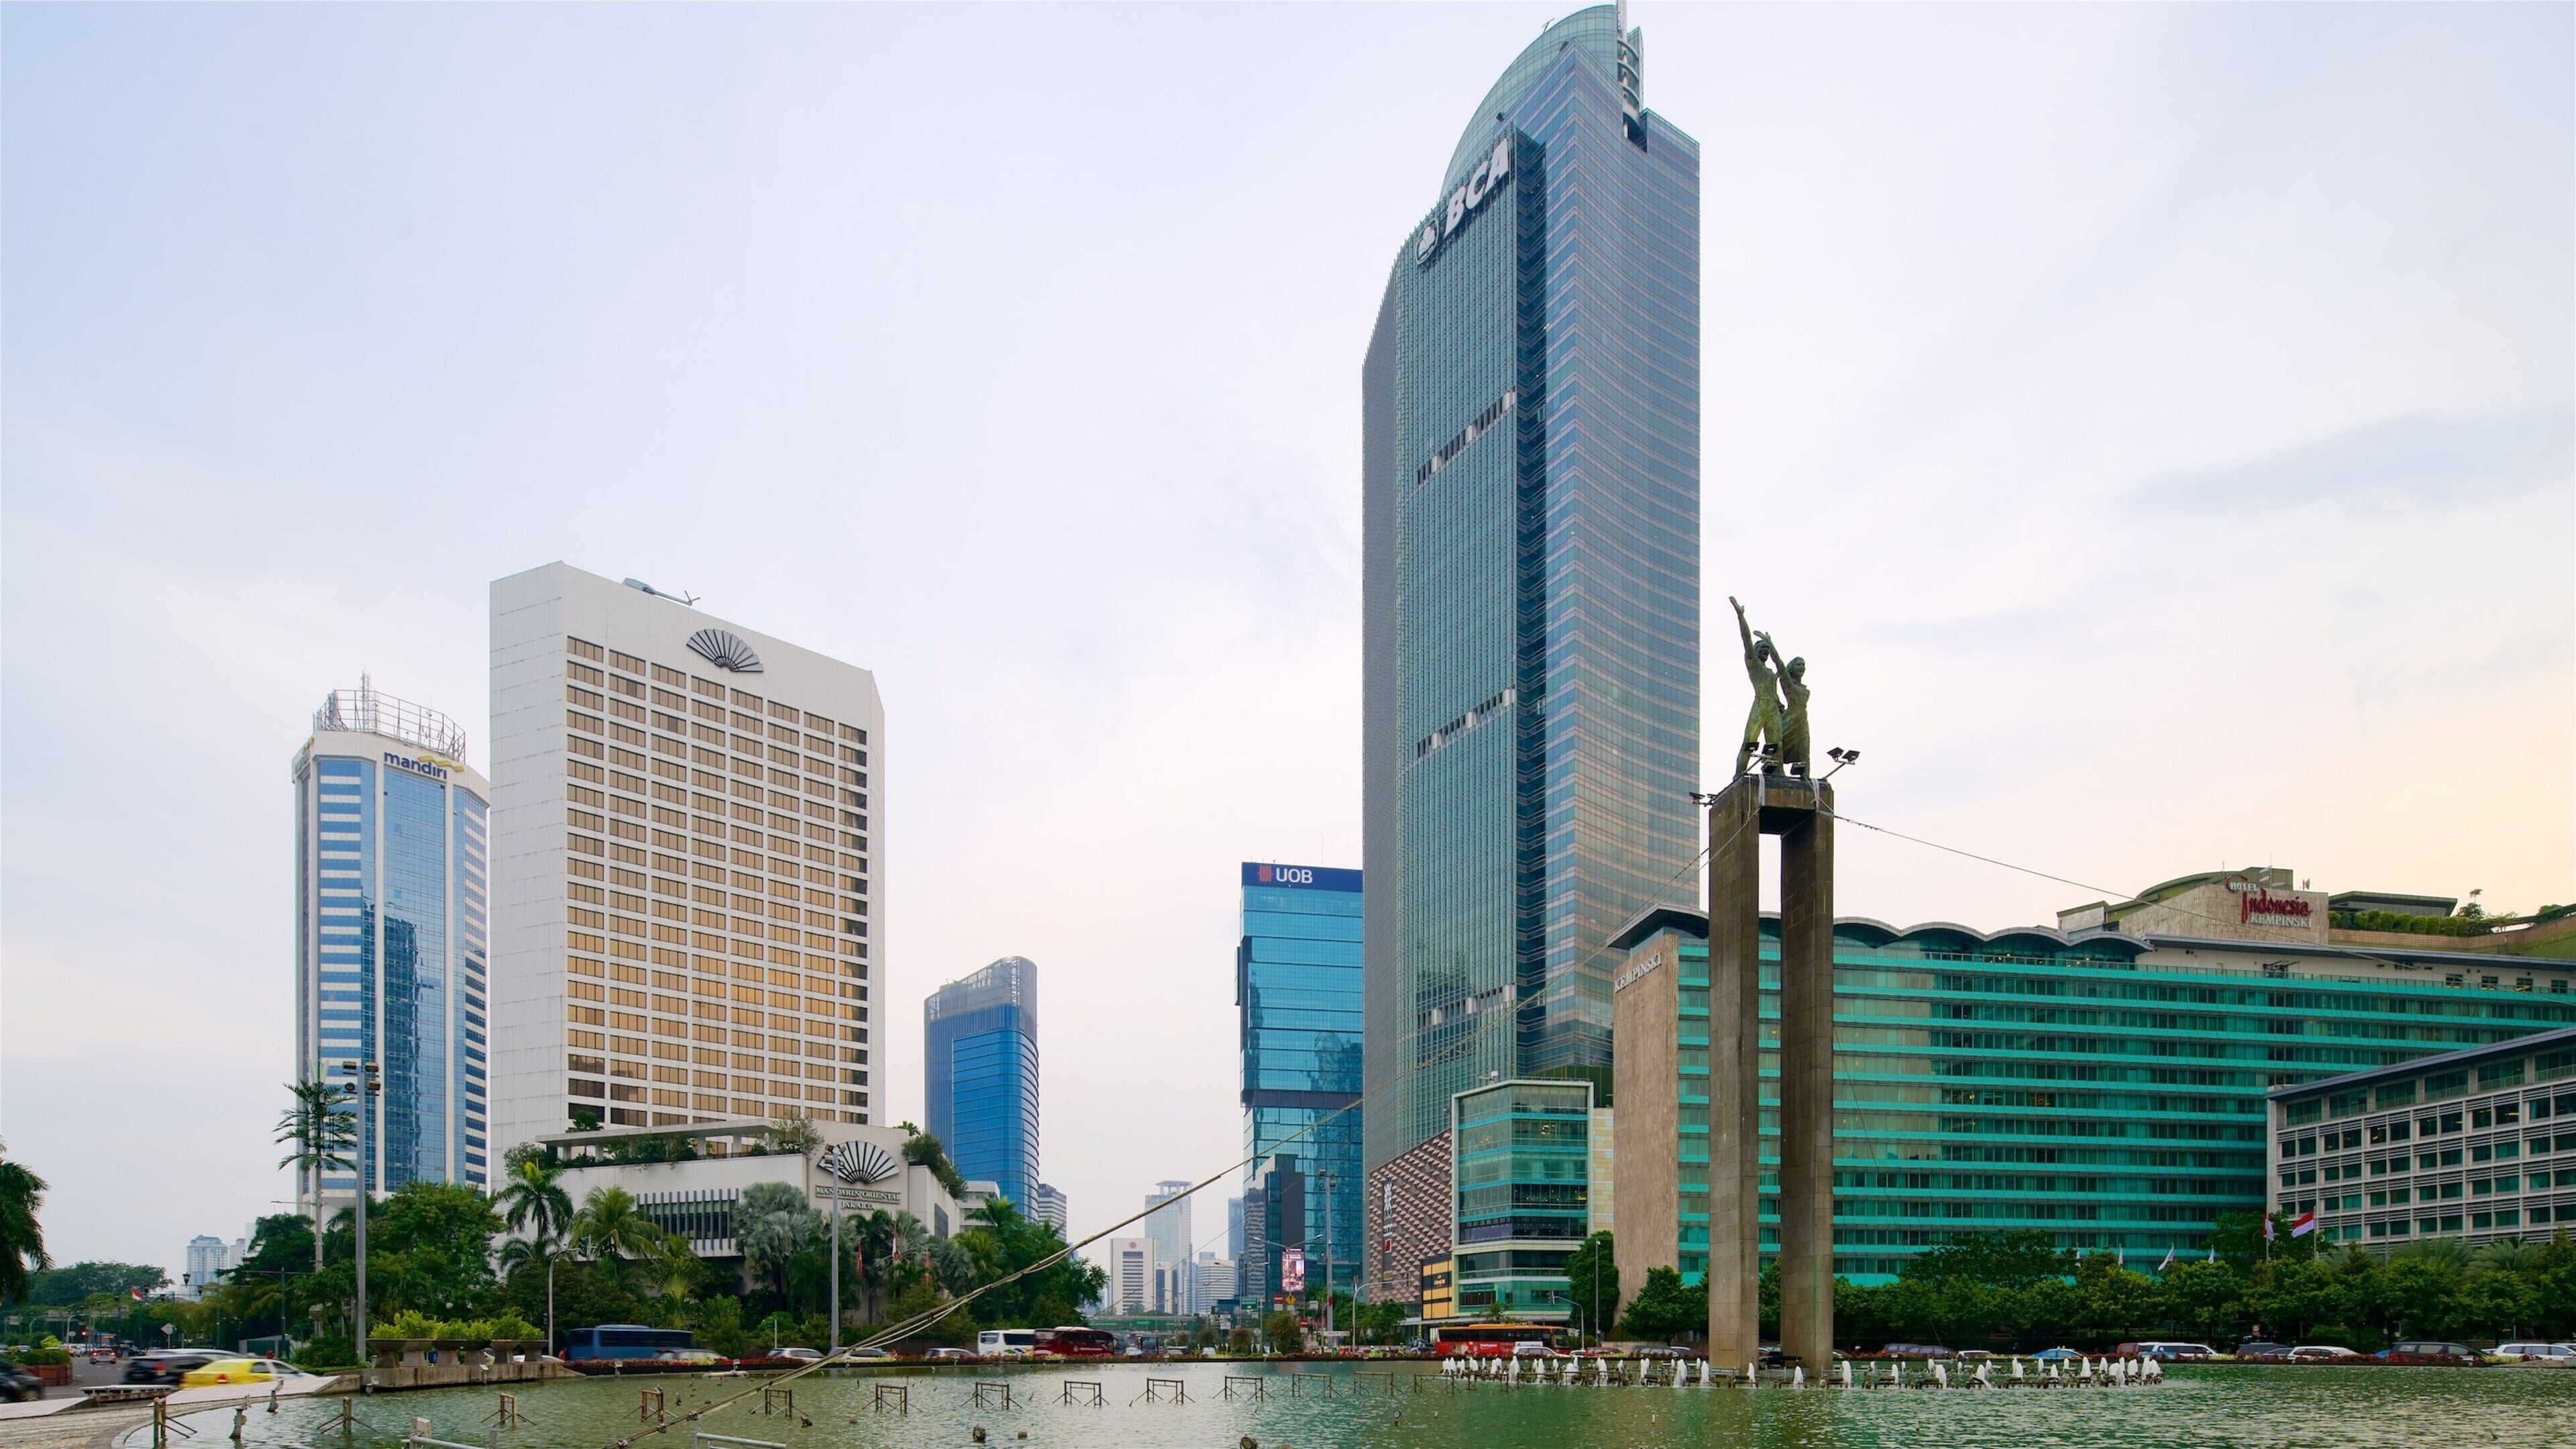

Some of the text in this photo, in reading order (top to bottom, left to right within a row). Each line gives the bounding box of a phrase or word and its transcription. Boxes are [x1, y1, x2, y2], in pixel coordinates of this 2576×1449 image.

[1444, 138, 1509, 238] BCA
[384, 751, 447, 780] mandiri
[1276, 867, 1313, 884] UOB
[2230, 882, 2257, 892] HOTEL
[2241, 887, 2313, 924] Indonesia
[2250, 913, 2312, 928] KEMPINSKI
[862, 1191, 900, 1201] ORIENTAL
[841, 1201, 875, 1210] JAKARTA
